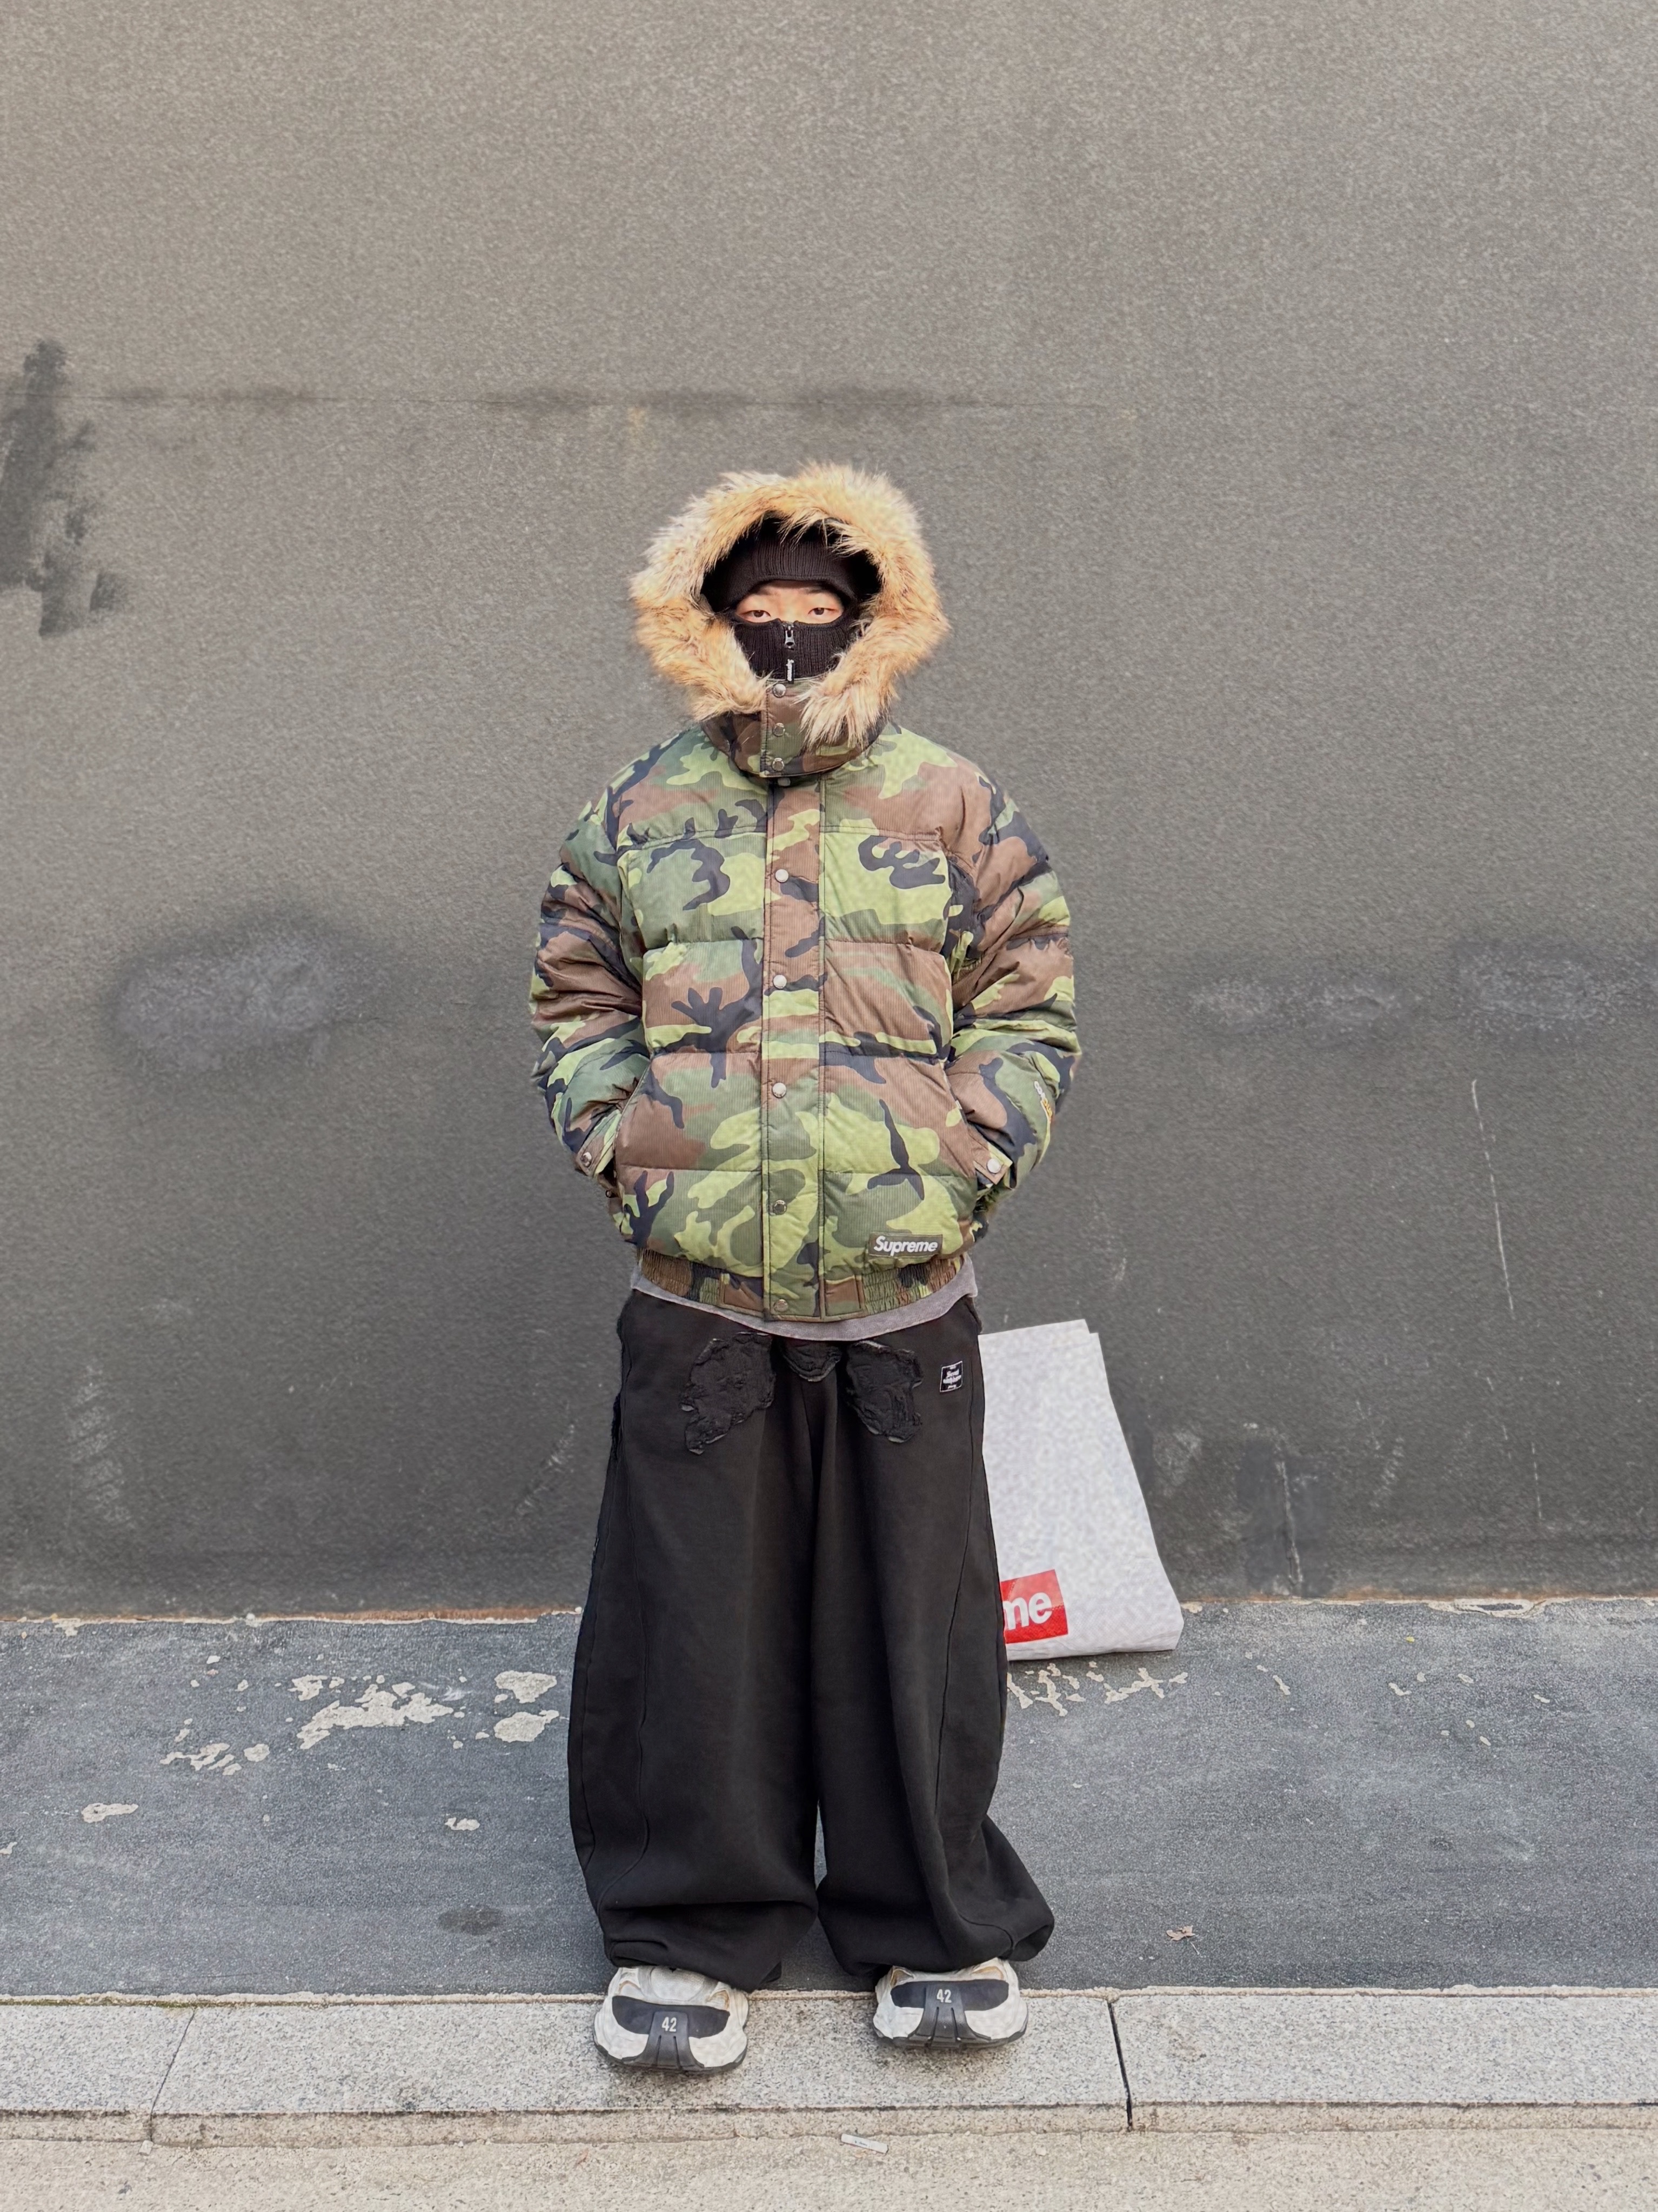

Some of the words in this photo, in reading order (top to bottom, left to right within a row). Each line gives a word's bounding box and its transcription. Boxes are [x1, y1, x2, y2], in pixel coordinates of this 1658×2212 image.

[873, 1235, 938, 1256] Supreme
[936, 1989, 952, 2003] 42
[661, 2017, 677, 2032] 42
